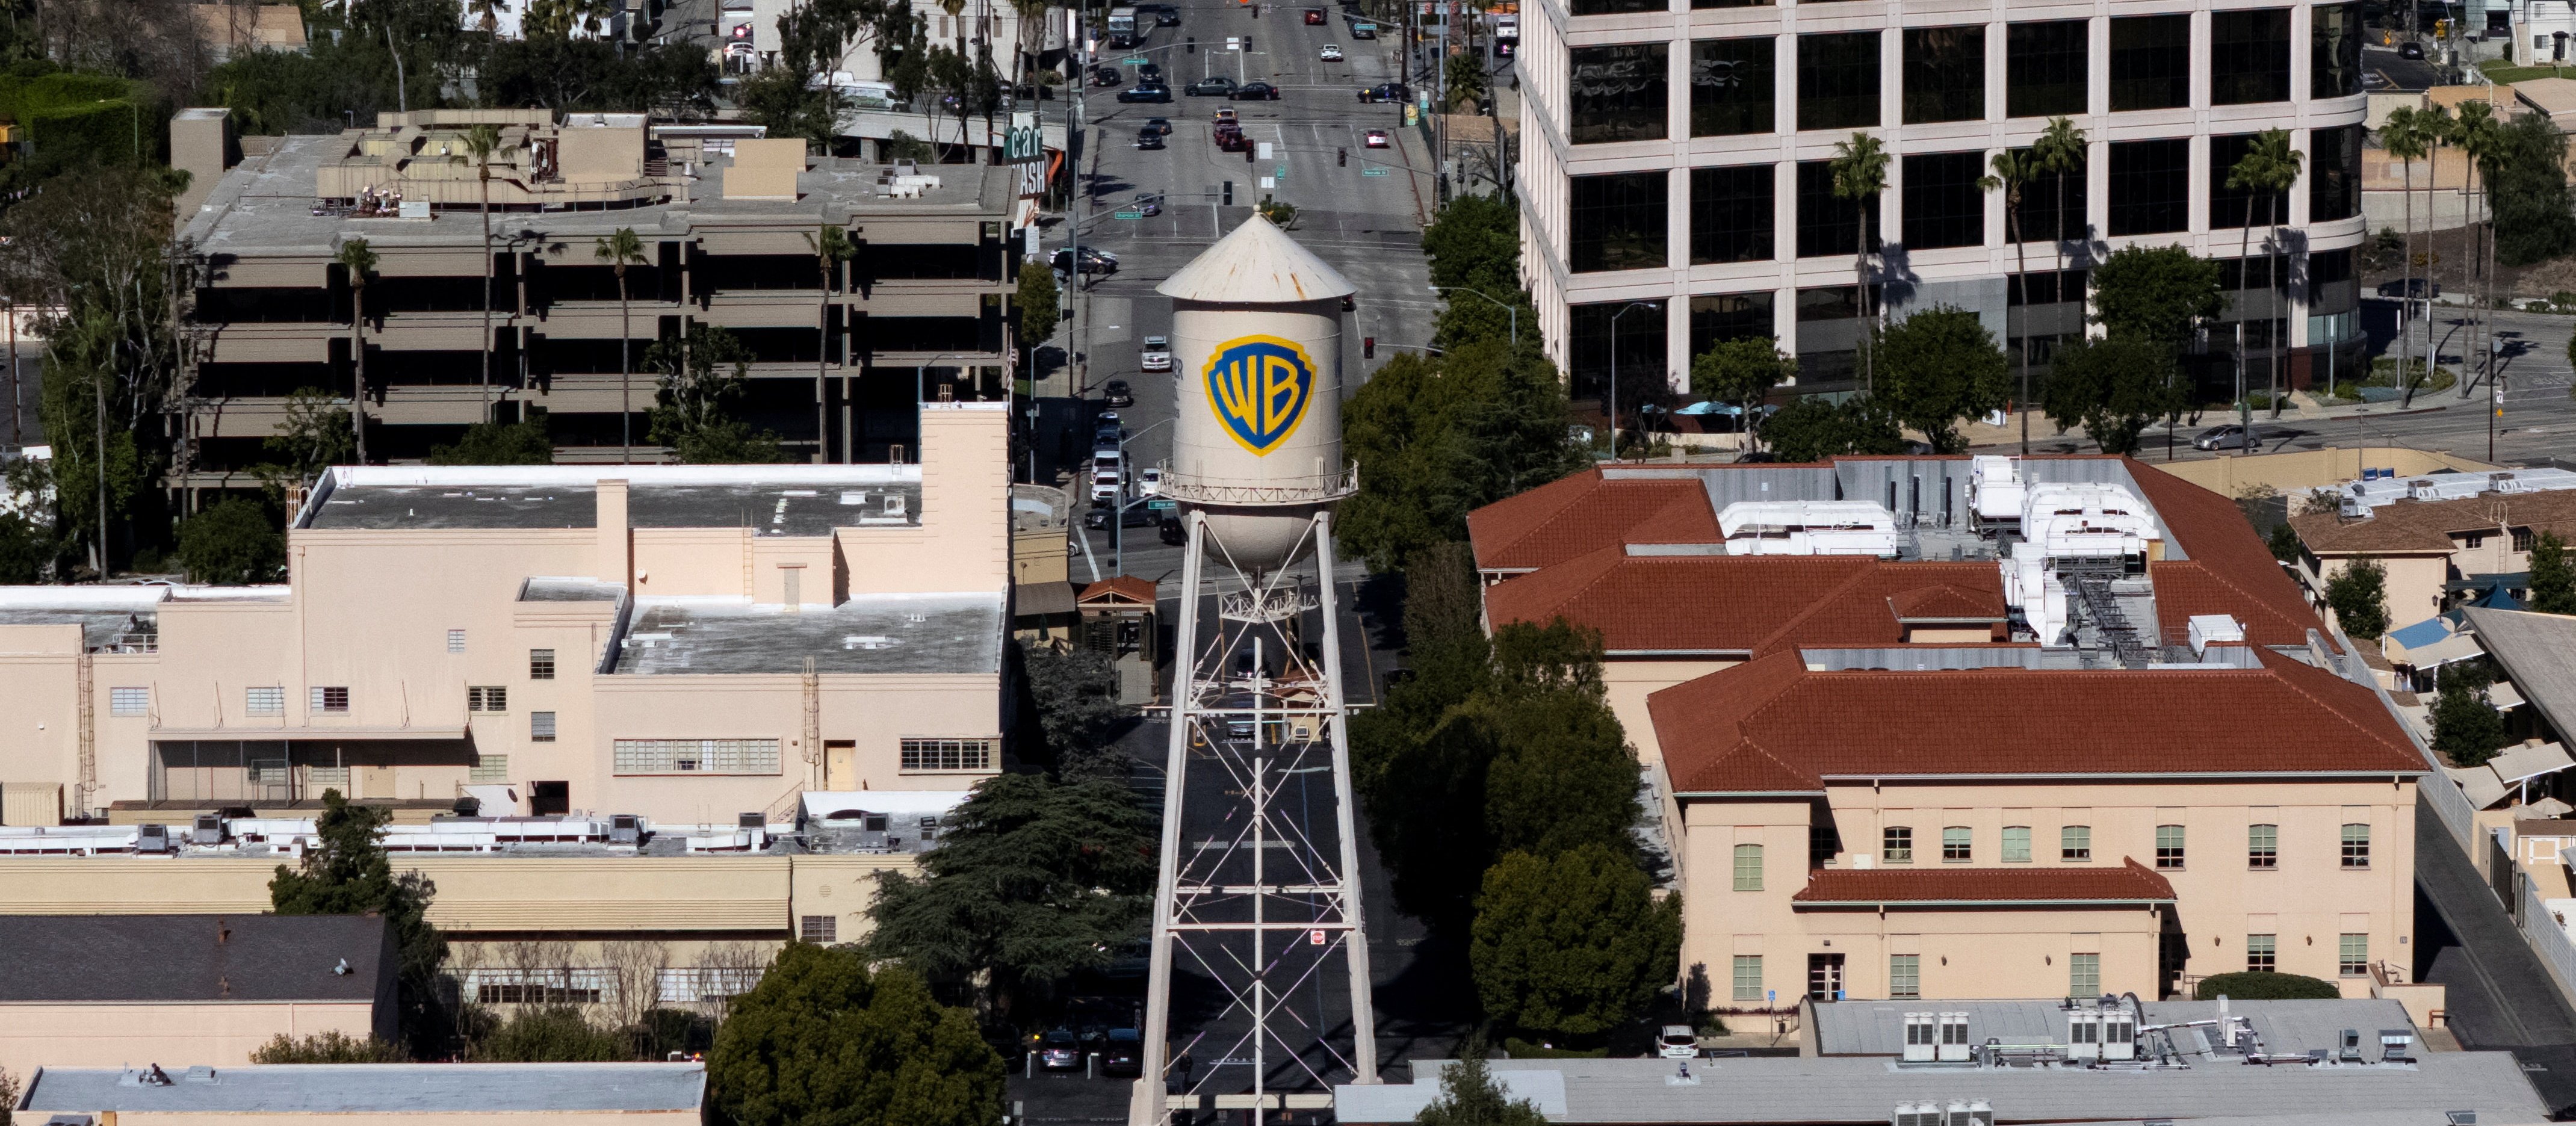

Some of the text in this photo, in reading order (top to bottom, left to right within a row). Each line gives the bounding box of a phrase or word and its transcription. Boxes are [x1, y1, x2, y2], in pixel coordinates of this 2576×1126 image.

[1012, 128, 1041, 158] car
[1009, 161, 1045, 195] ASH
[1216, 355, 1300, 436] WB
